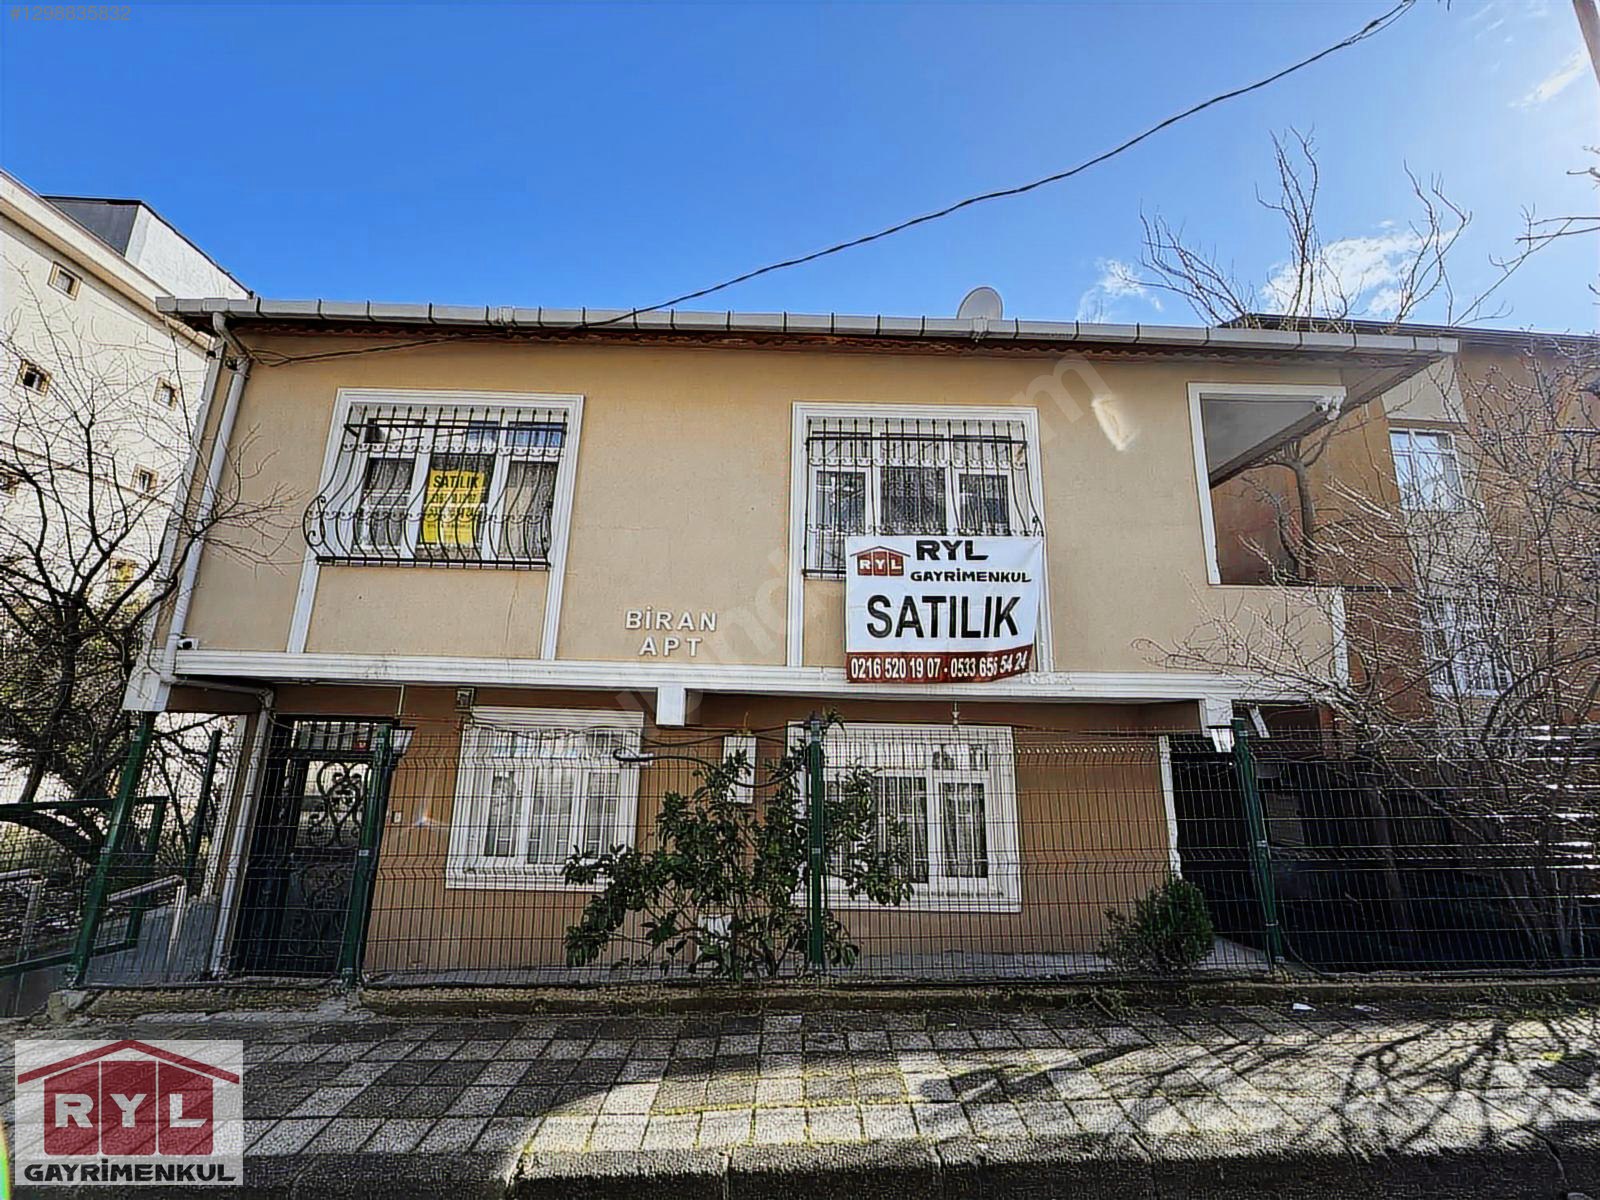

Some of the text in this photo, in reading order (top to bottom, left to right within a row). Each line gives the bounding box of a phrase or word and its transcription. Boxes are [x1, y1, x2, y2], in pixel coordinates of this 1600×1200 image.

[916, 540, 989, 561] RYL
[859, 559, 903, 570] RYL
[910, 568, 1032, 583] GAYRİMENKUL
[625, 606, 717, 632] BİRAN
[867, 595, 1021, 639] SATILIK
[639, 636, 703, 657] APT
[851, 657, 881, 678] 0216
[885, 657, 907, 678] 520
[910, 657, 924, 678] 19
[927, 657, 941, 678] 07
[950, 657, 976, 678] 0533
[1000, 653, 1014, 674] 54
